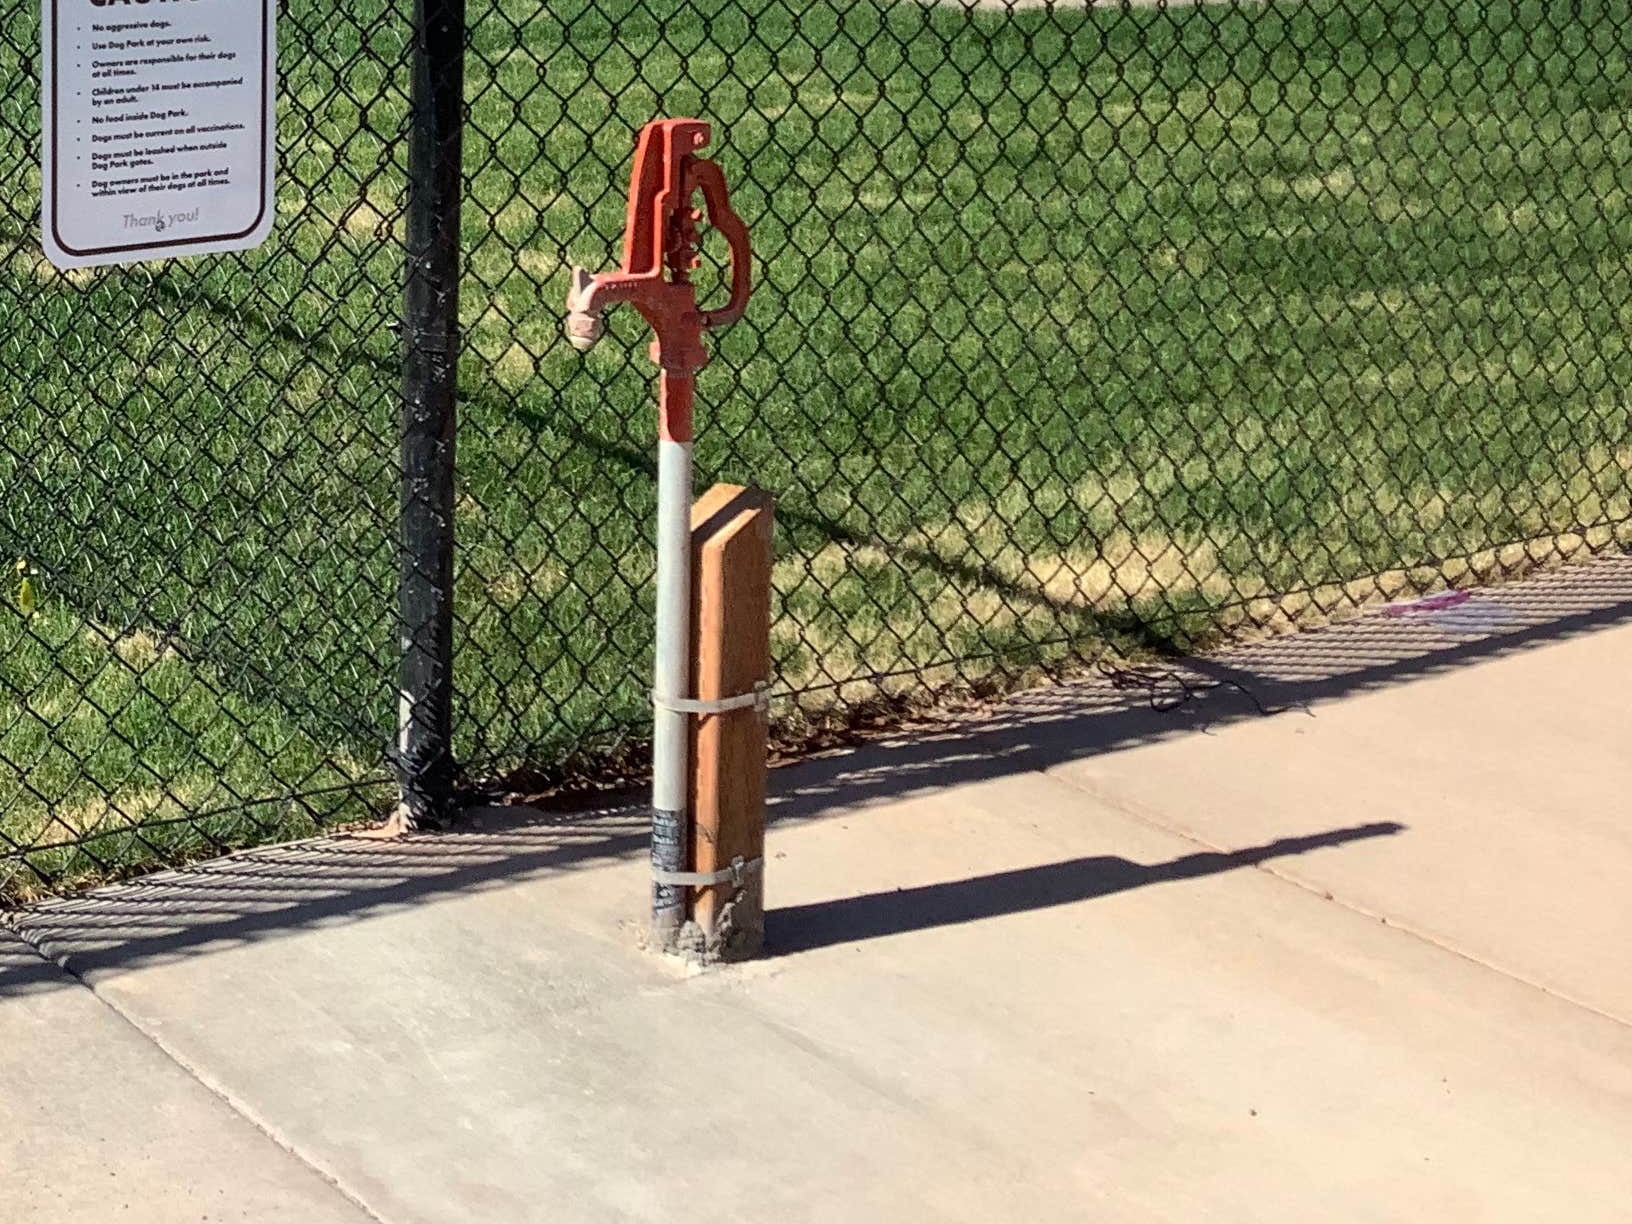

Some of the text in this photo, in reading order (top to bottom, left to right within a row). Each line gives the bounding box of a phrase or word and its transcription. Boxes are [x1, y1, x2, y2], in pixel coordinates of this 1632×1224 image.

[108, 41, 124, 50] Dog
[126, 39, 144, 47] Park
[150, 111, 166, 120] Dog
[92, 162, 108, 171] Dog
[110, 160, 128, 168] Park
[92, 180, 108, 189] Dog
[123, 207, 200, 228] Thank you!
